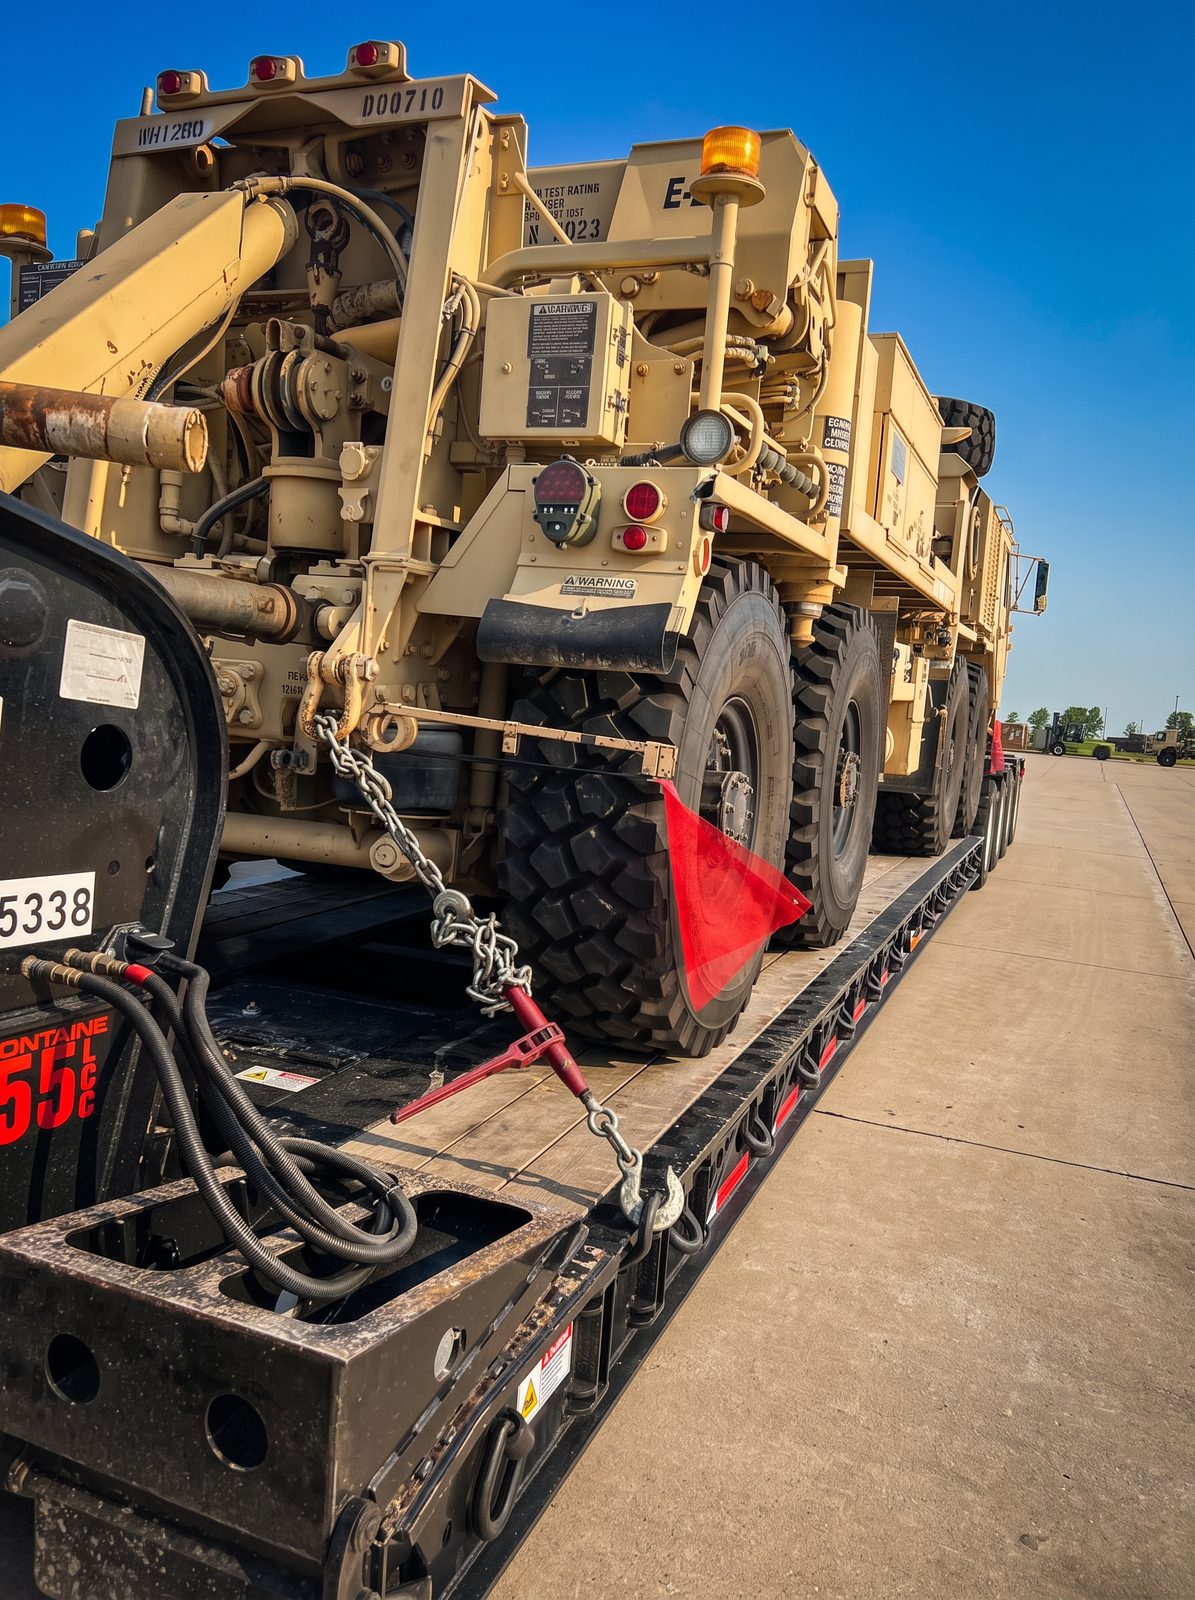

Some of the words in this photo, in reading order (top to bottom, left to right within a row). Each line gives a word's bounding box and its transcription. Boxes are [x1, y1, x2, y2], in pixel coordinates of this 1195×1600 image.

[545, 186, 565, 198] TEST
[567, 182, 600, 196] RATING
[579, 576, 635, 589] WARNING
[0, 886, 92, 938] 5338
